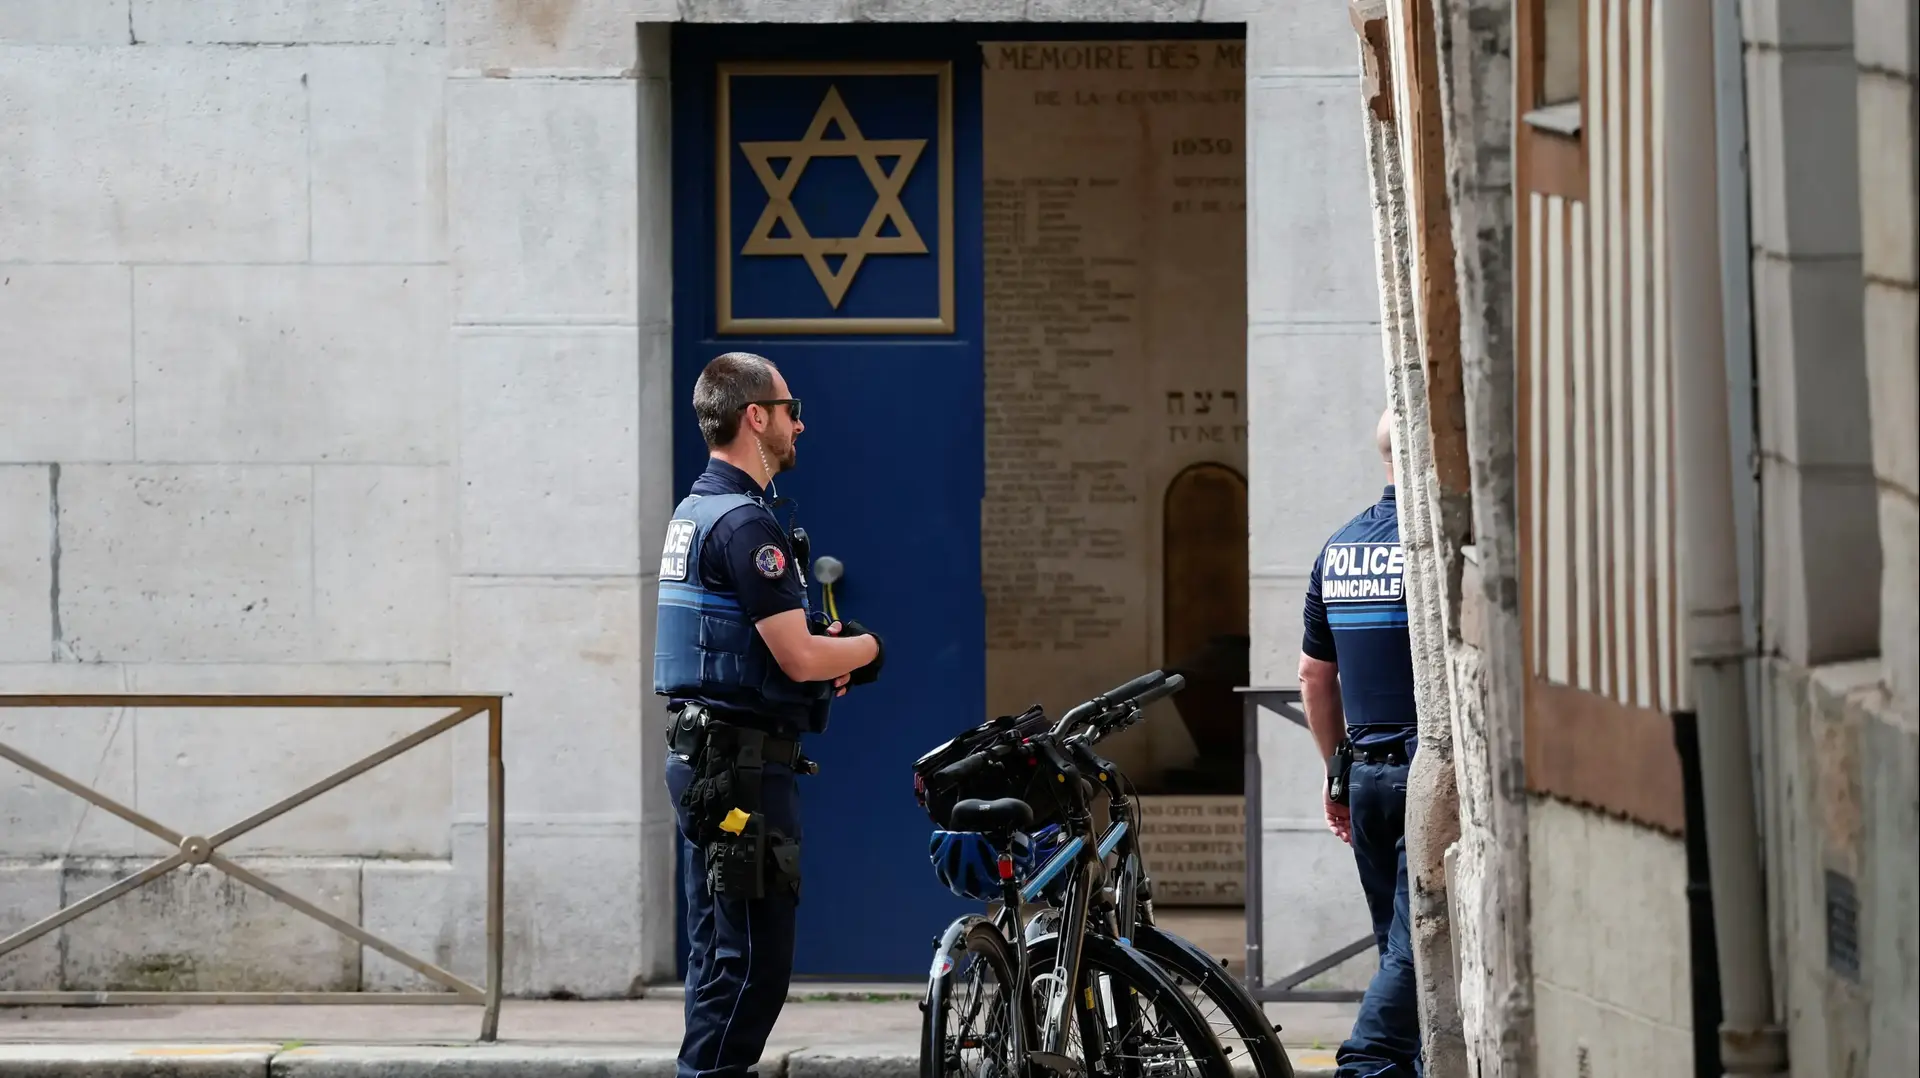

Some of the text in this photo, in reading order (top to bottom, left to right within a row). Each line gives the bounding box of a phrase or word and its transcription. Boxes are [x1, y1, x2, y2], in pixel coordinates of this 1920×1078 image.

[999, 46, 1133, 71] MEMOIRE
[1146, 45, 1201, 70] DES
[1034, 90, 1062, 106] DE
[1325, 546, 1404, 576] POLICE
[1323, 578, 1401, 598] MUNICIPALE
